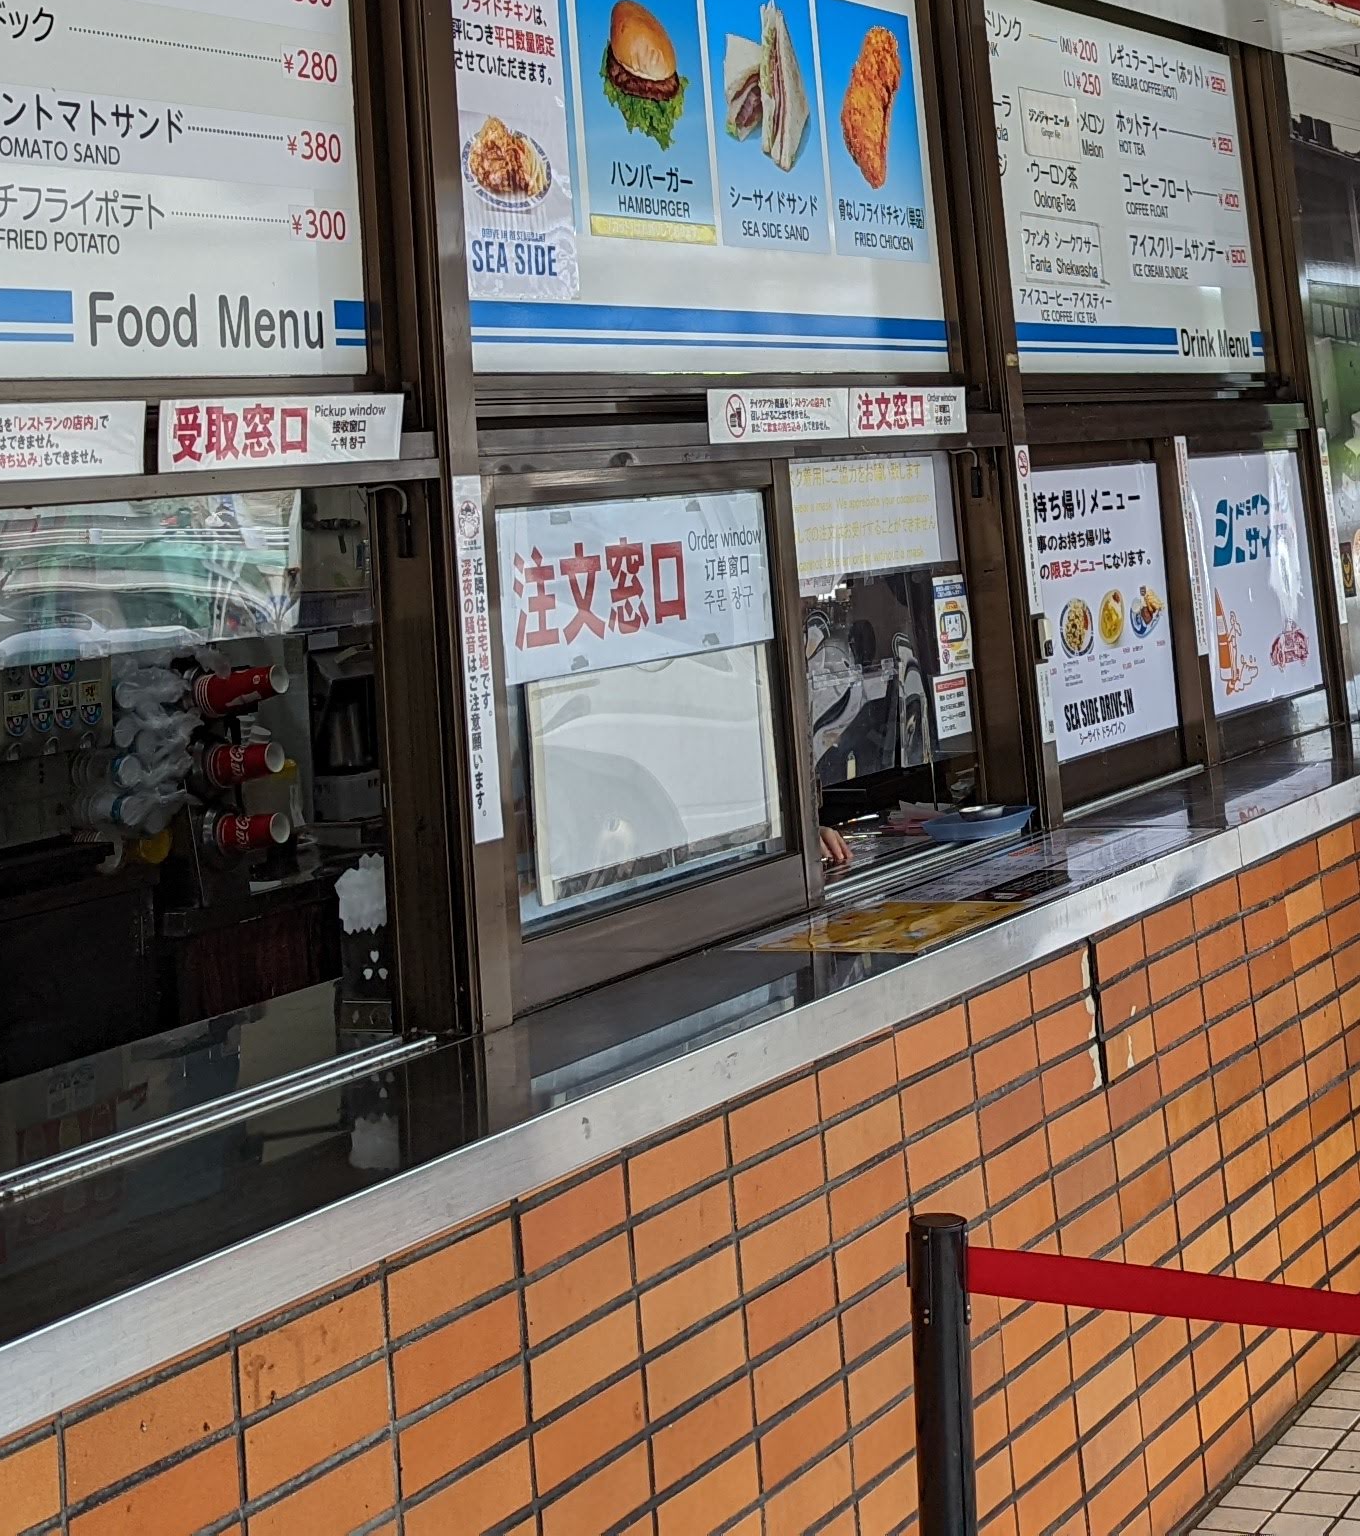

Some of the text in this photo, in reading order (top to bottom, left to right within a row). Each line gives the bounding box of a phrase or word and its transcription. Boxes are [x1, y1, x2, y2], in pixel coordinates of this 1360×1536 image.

[283, 48, 339, 85] ¥280
[454, 48, 553, 86] させていただきます。
[1116, 109, 1168, 141] ホットティー
[72, 137, 122, 167] SAND
[286, 130, 343, 165] ¥380
[1081, 138, 1105, 159] Melon
[1119, 139, 1146, 156] HOT TEA
[611, 160, 694, 194] ハンバーガー
[1123, 173, 1193, 203] コーヒーフロート
[617, 194, 691, 219] HAMBURGER
[729, 185, 819, 217] シーサイドサンド
[1033, 189, 1077, 213] Oolong-Tea
[1125, 201, 1150, 217] COFFEE
[290, 208, 347, 242] ¥300
[742, 220, 810, 243] SEA SIDE SAND
[52, 229, 121, 256] POTATO
[854, 231, 914, 253] FRIED CHICKEN
[1129, 234, 1224, 263] アイスクリームサンデー
[471, 239, 558, 277] SEA SIDE
[1030, 254, 1053, 273] Fanta
[1132, 263, 1143, 277] ICE
[1143, 264, 1165, 279] CREAM
[89, 291, 326, 353] Food Menu
[1180, 328, 1250, 359] Drink Menu
[314, 403, 387, 418] Pickup window
[857, 392, 926, 432] 注文窓口
[172, 403, 309, 464] 受取窓口
[1033, 487, 1141, 524] 持ち帰りメニュー
[687, 524, 763, 553] Order window
[512, 536, 689, 653] 注文窓口
[703, 585, 755, 614] 주문 창구
[1064, 702, 1081, 733] SEA
[1080, 697, 1101, 728] SIDE
[1099, 688, 1135, 723] DRIVE-IN
